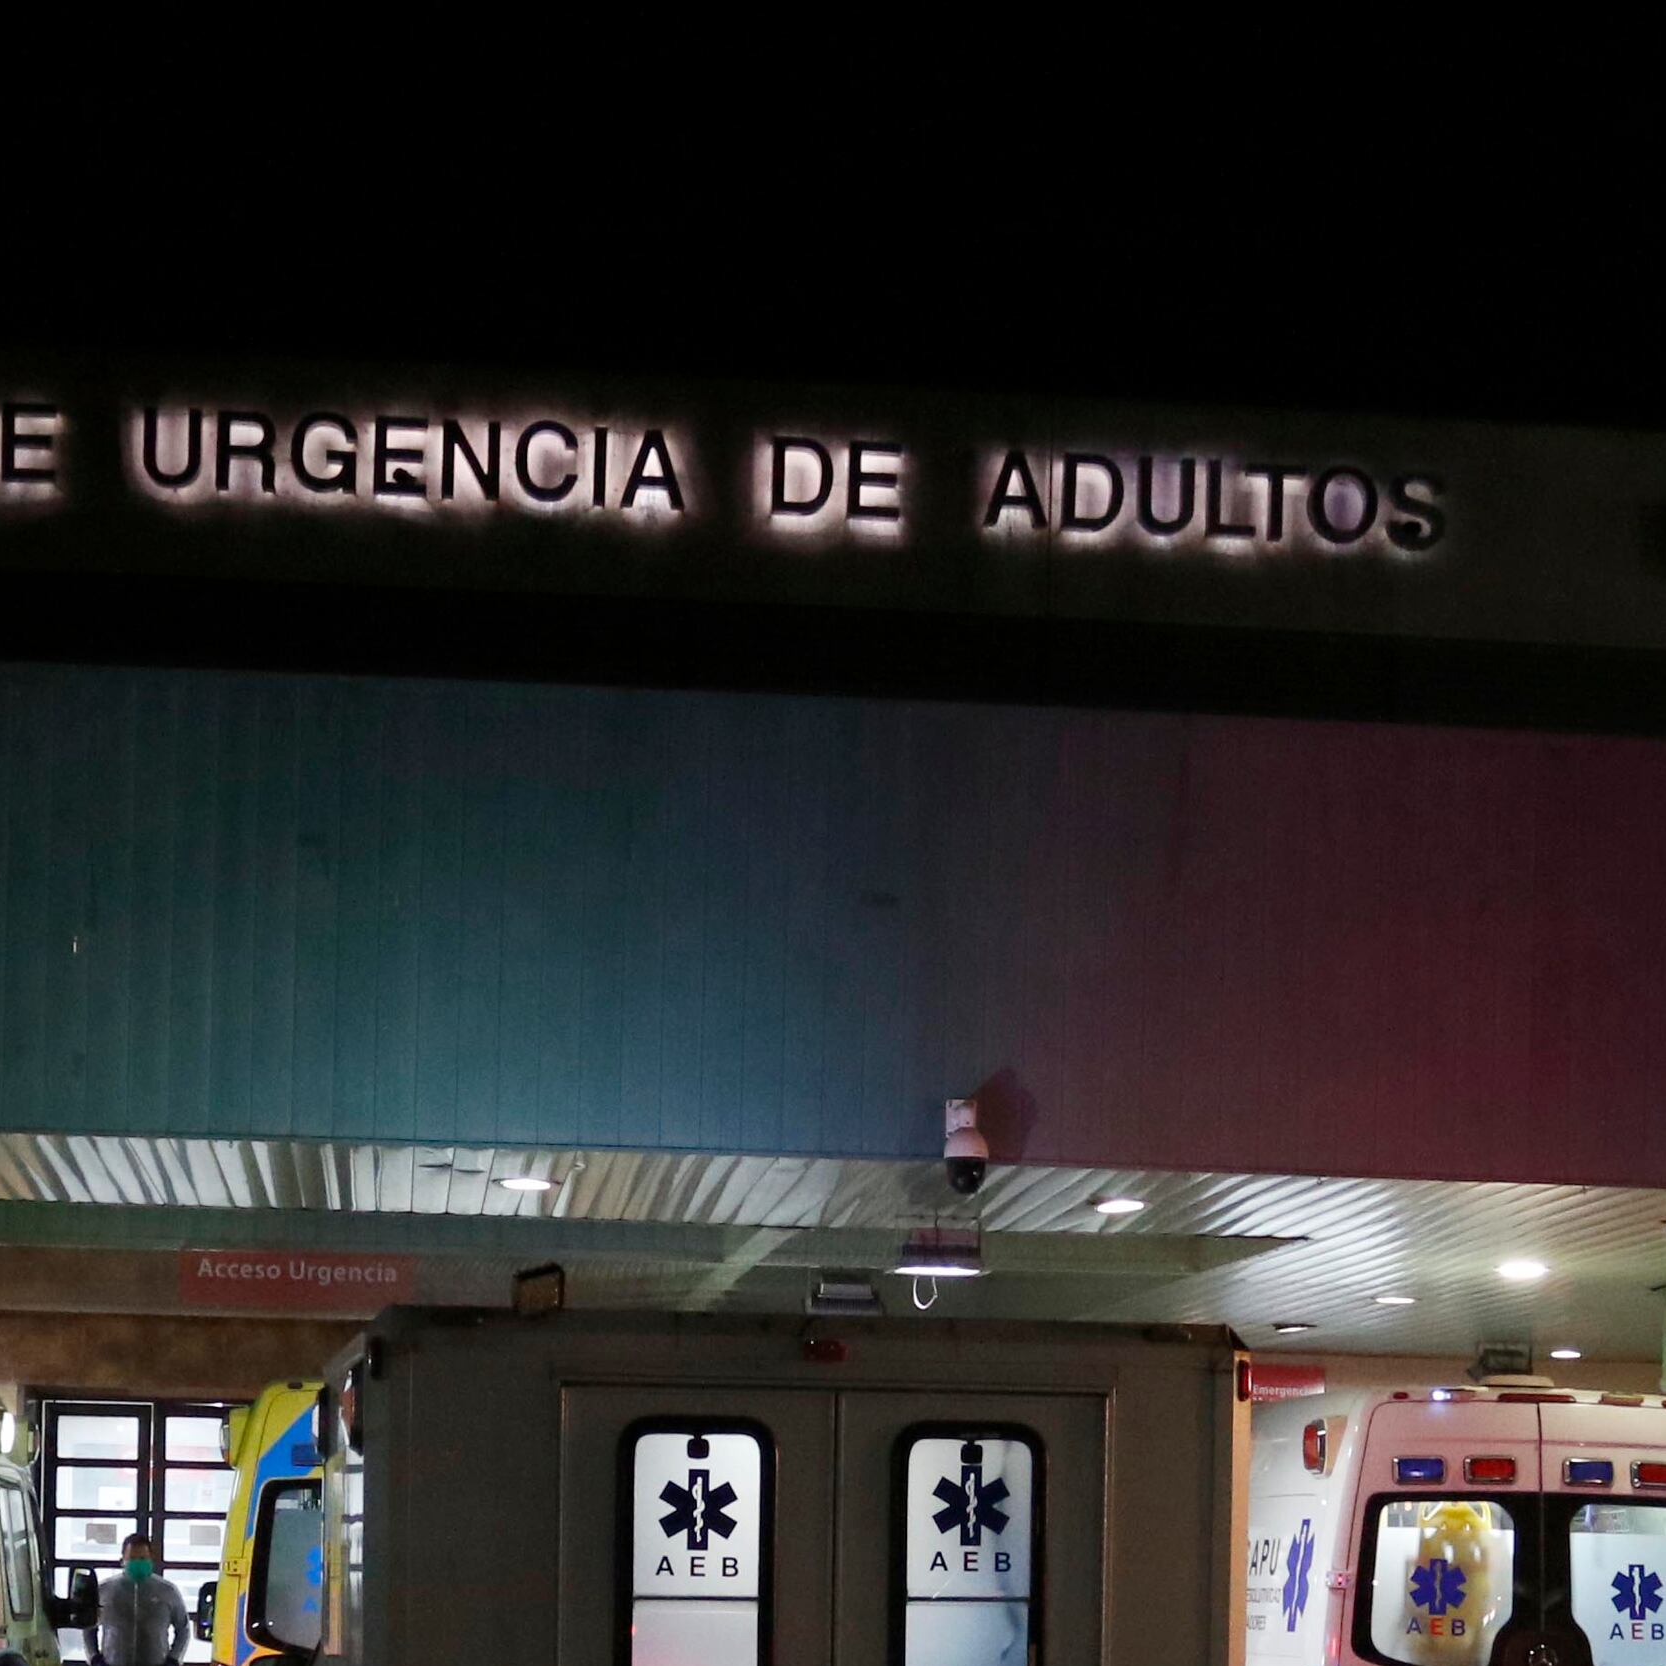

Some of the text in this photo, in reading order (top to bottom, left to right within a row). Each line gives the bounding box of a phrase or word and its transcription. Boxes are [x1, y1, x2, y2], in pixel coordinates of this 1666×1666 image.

[142, 407, 685, 511] URGENCIA
[769, 437, 902, 521] DE
[983, 449, 1446, 552] ADULTOS
[197, 1257, 397, 1286] Acceso Urgencia
[1247, 1537, 1281, 1576] APU
